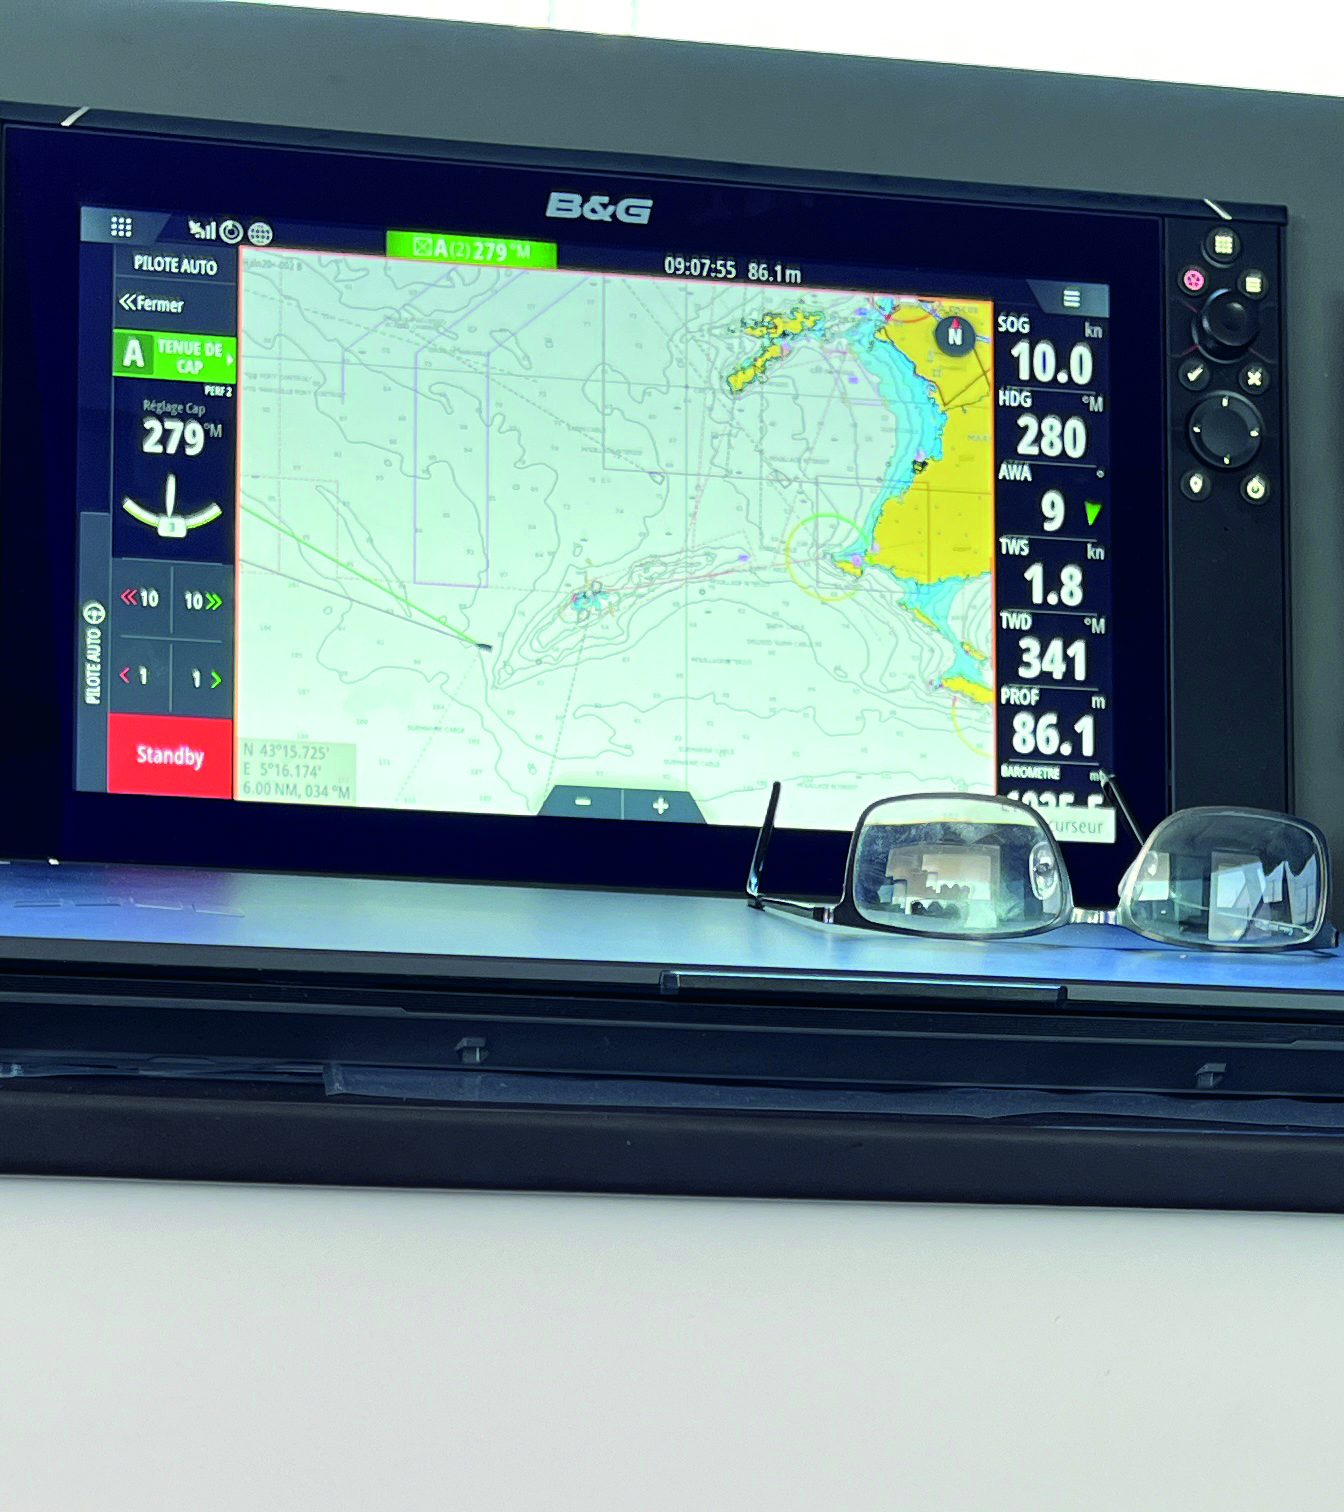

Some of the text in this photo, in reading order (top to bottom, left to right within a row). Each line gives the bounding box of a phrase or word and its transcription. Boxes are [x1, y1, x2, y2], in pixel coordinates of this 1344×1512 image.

[545, 190, 653, 225] B&G
[473, 240, 508, 261] 279
[133, 254, 218, 276] PILOTE AUTO
[664, 255, 737, 280] 09:07:55
[137, 295, 184, 313] Fermer
[948, 327, 962, 345] N
[997, 315, 1103, 339] SOG kn
[122, 337, 145, 368] A
[157, 338, 223, 358] TENUE DE
[176, 359, 204, 375] CAP
[1010, 339, 1093, 385] 10.0
[204, 384, 225, 397] PERF
[226, 386, 233, 398] 2
[998, 389, 1033, 408] HDG
[143, 399, 206, 418] Réglage Cap
[142, 418, 205, 456] 279
[1016, 414, 1087, 459] 280
[998, 463, 1033, 482] AWA
[1041, 489, 1065, 532] 9
[999, 537, 1105, 561] TWS kn
[1023, 562, 1083, 607] 1.8
[140, 588, 159, 607] 10
[184, 591, 203, 610] 10
[1000, 611, 1033, 630] TWD
[85, 627, 102, 662] AUTO
[1018, 636, 1087, 681] 341
[85, 663, 101, 705] PILOTE
[1001, 687, 1106, 709] PROF m
[1012, 711, 1095, 757] 86.1
[136, 745, 205, 771] Standby
[243, 743, 254, 757] N
[243, 762, 250, 776] E
[243, 781, 271, 796] 6.00
[275, 783, 302, 799] NM,
[305, 784, 329, 798] 034
